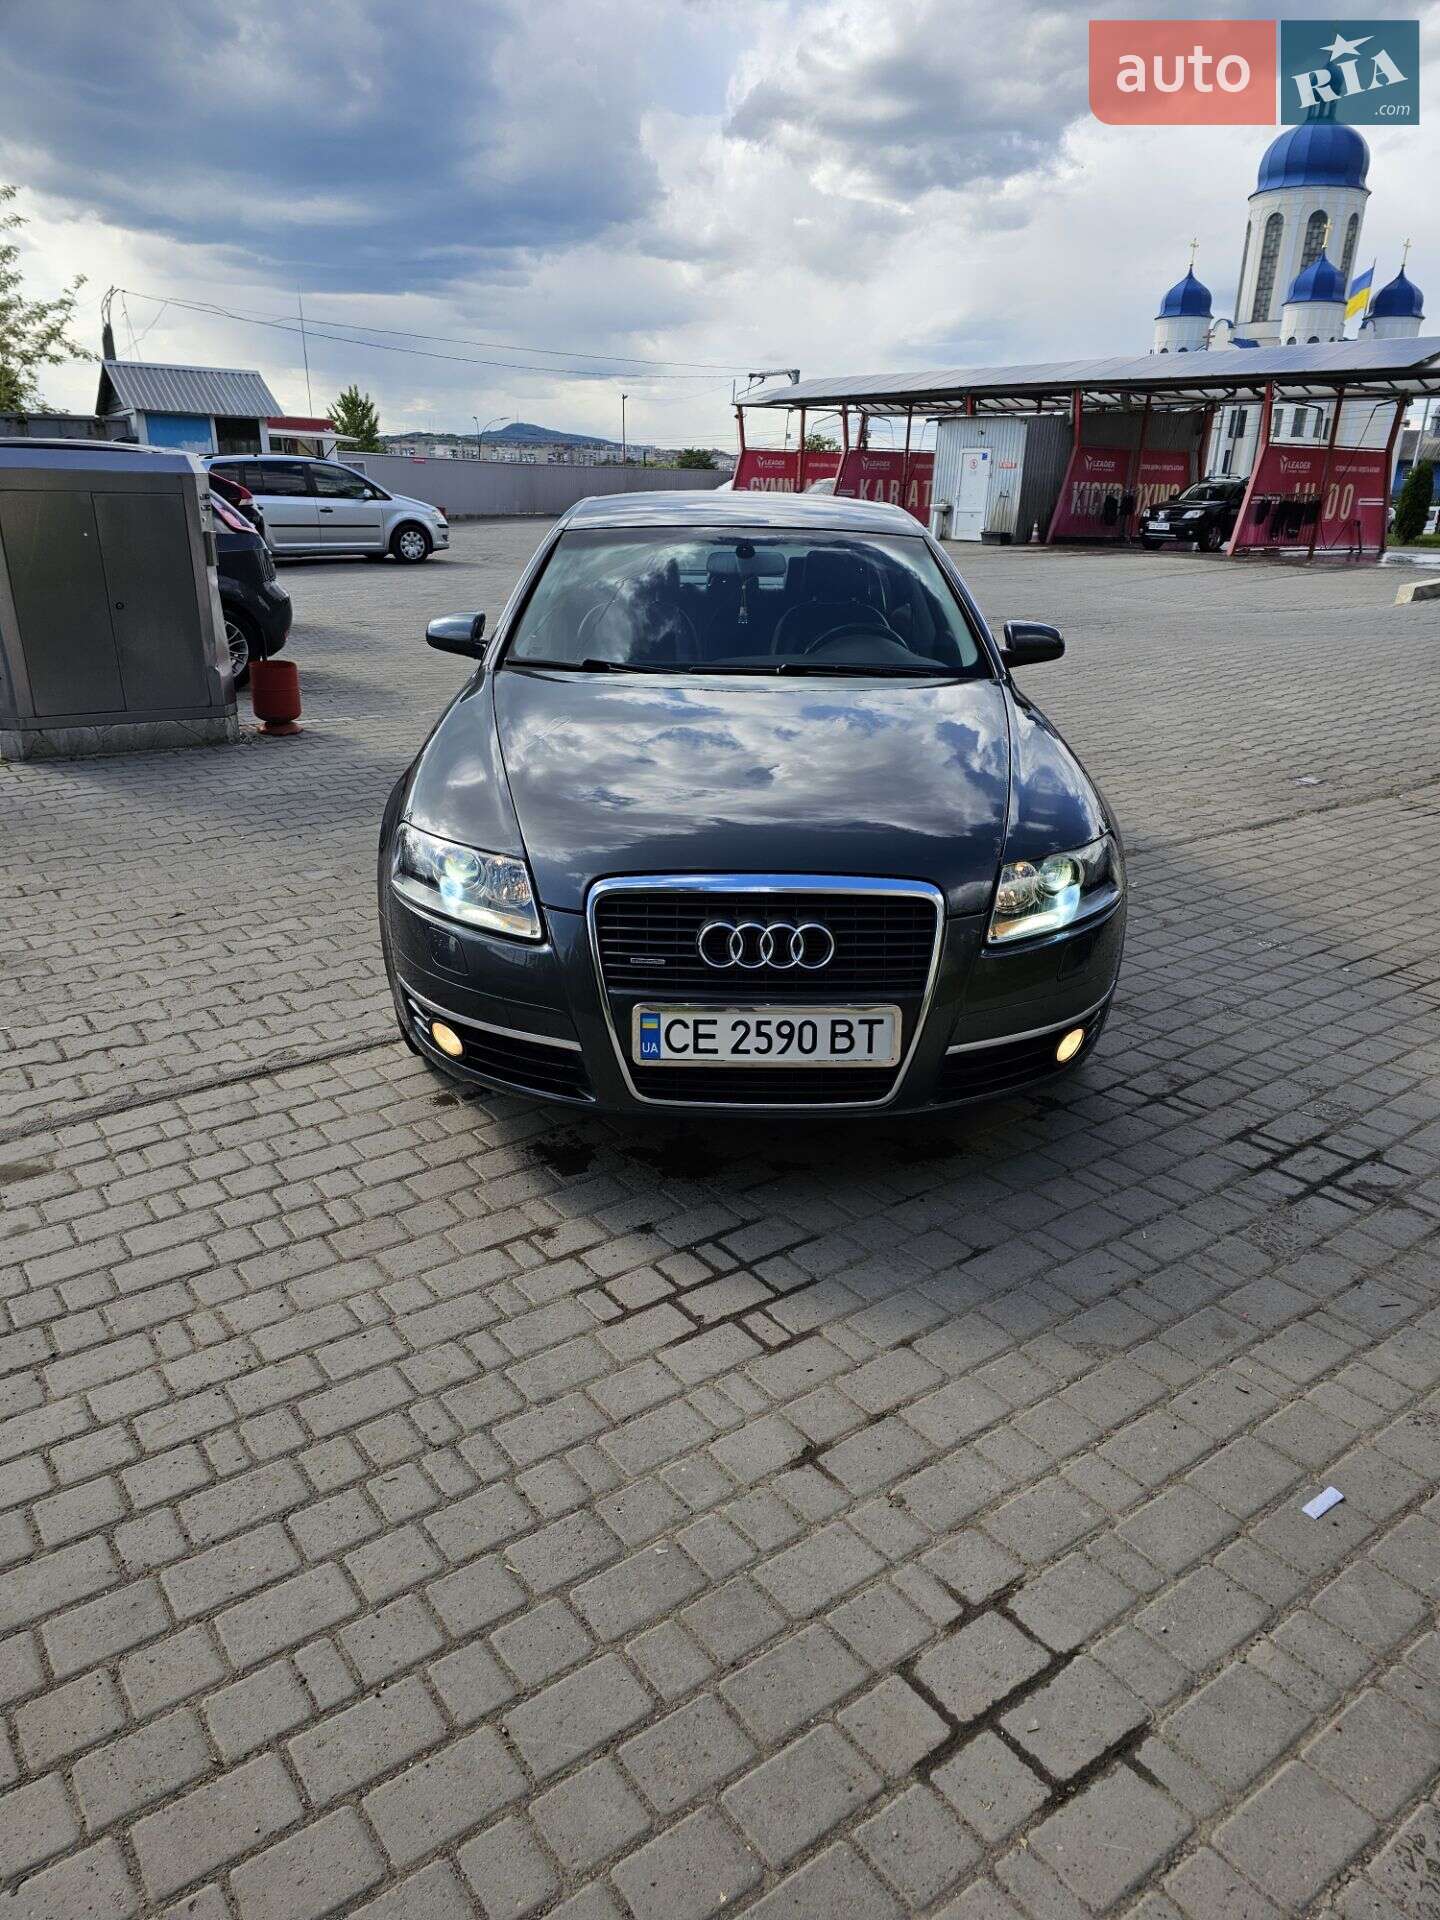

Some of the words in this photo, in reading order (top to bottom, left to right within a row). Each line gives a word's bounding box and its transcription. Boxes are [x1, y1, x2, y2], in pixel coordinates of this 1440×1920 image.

[641, 1043, 659, 1054] UA
[664, 1018, 719, 1055] CE
[730, 1019, 817, 1055] 2590
[829, 1018, 884, 1055] BT
